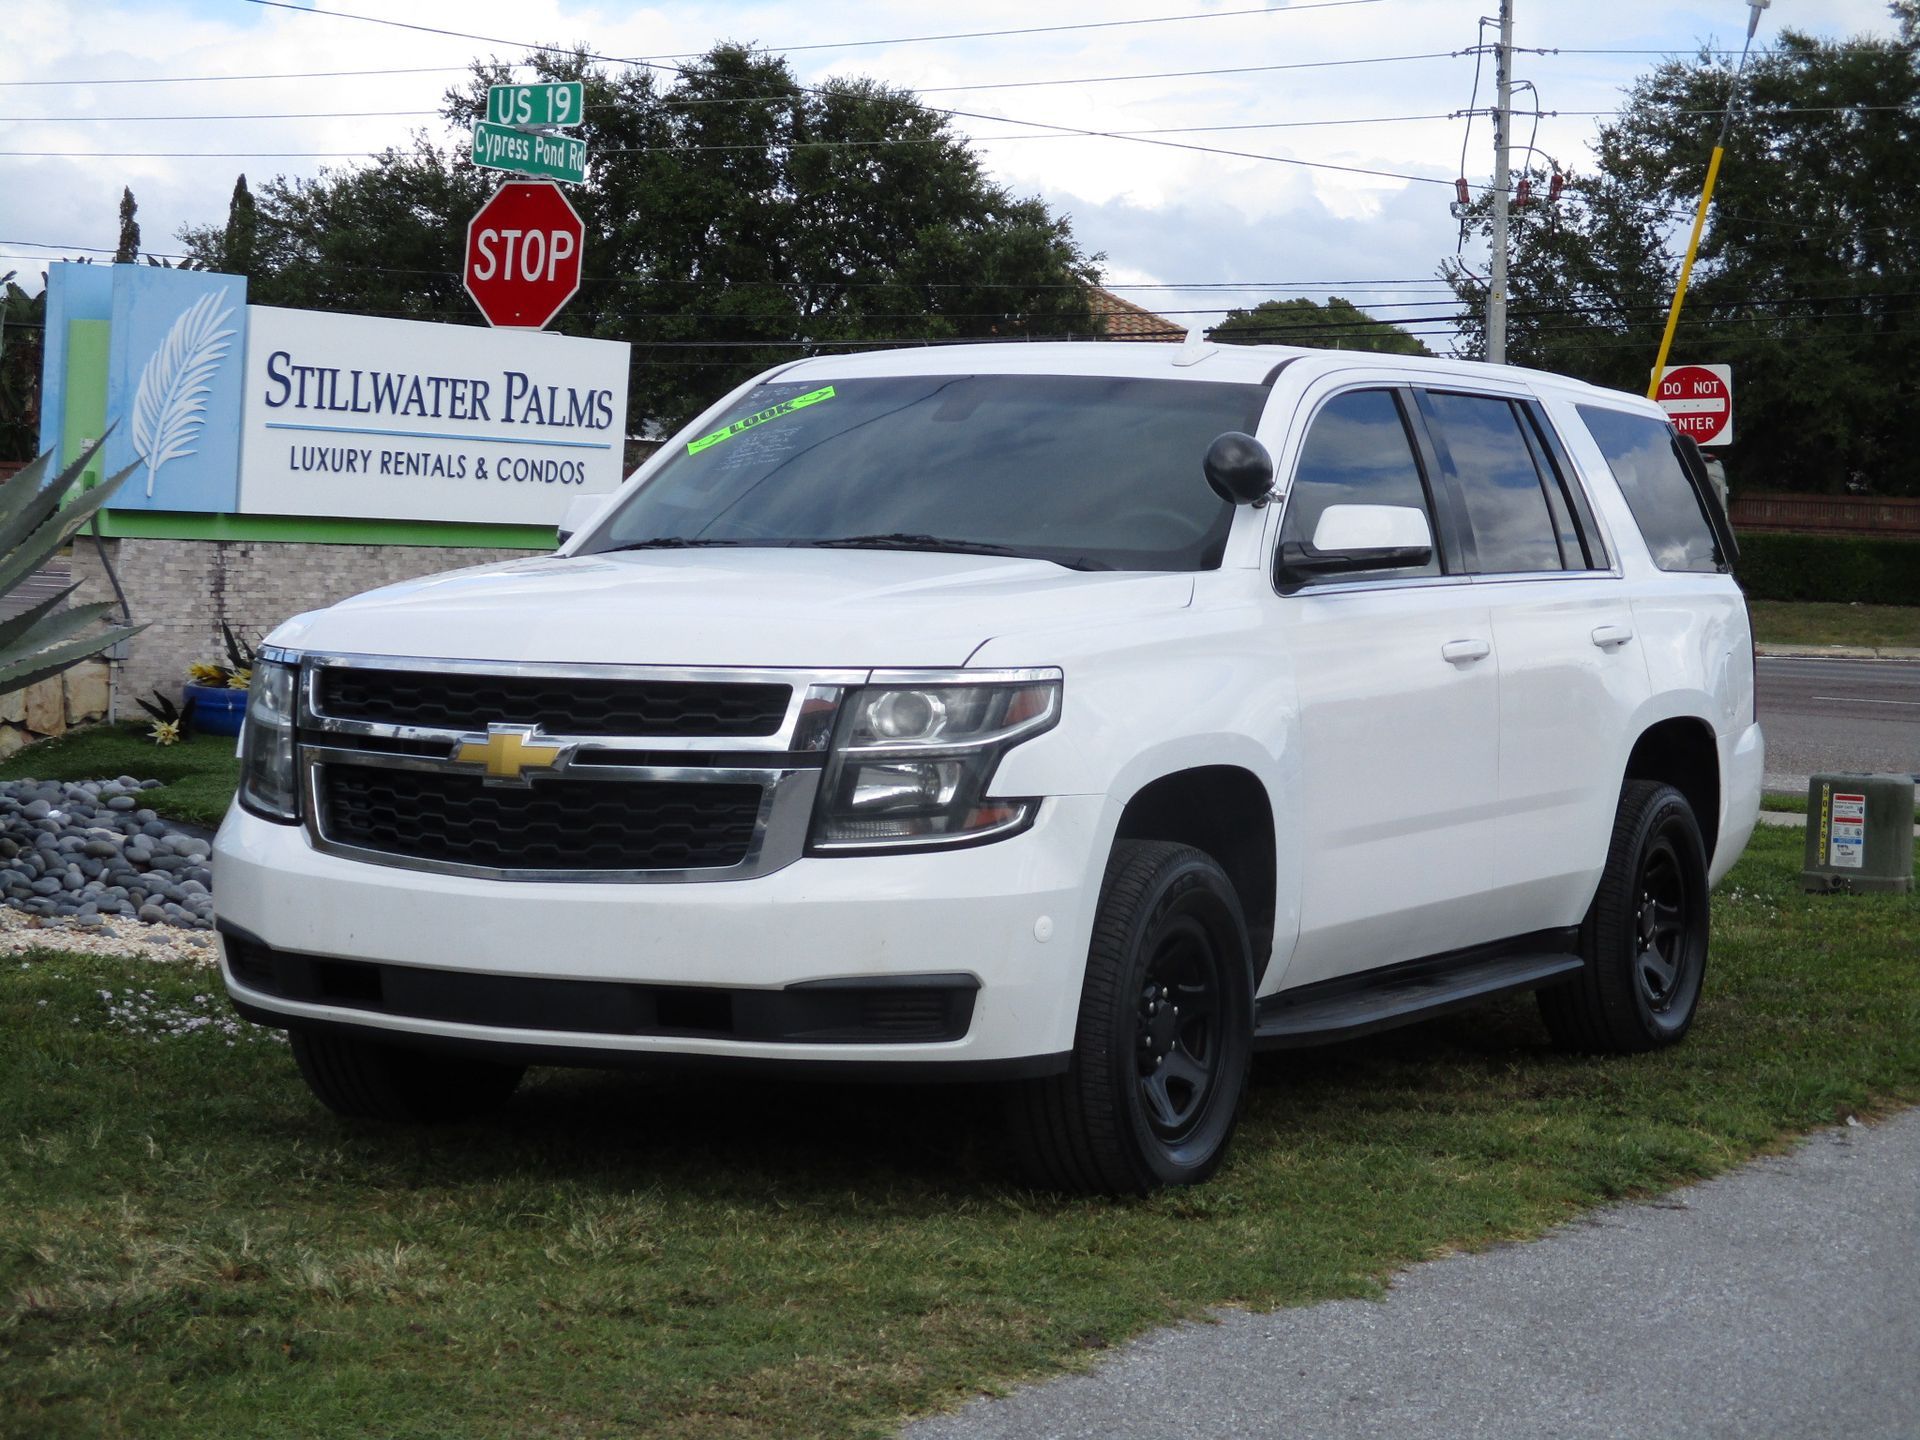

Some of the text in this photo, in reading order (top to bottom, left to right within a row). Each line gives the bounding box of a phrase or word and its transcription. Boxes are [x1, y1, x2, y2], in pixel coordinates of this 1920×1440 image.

[498, 86, 572, 125] US 19
[475, 125, 584, 172] Cypress Pond Rd
[473, 228, 574, 282] STOP
[265, 350, 614, 430] STILLWATER PALMS
[1663, 381, 1719, 395] DO NOT
[729, 400, 795, 435] LOOK
[290, 445, 585, 485] LUXURY RENTALS & CONDOS
